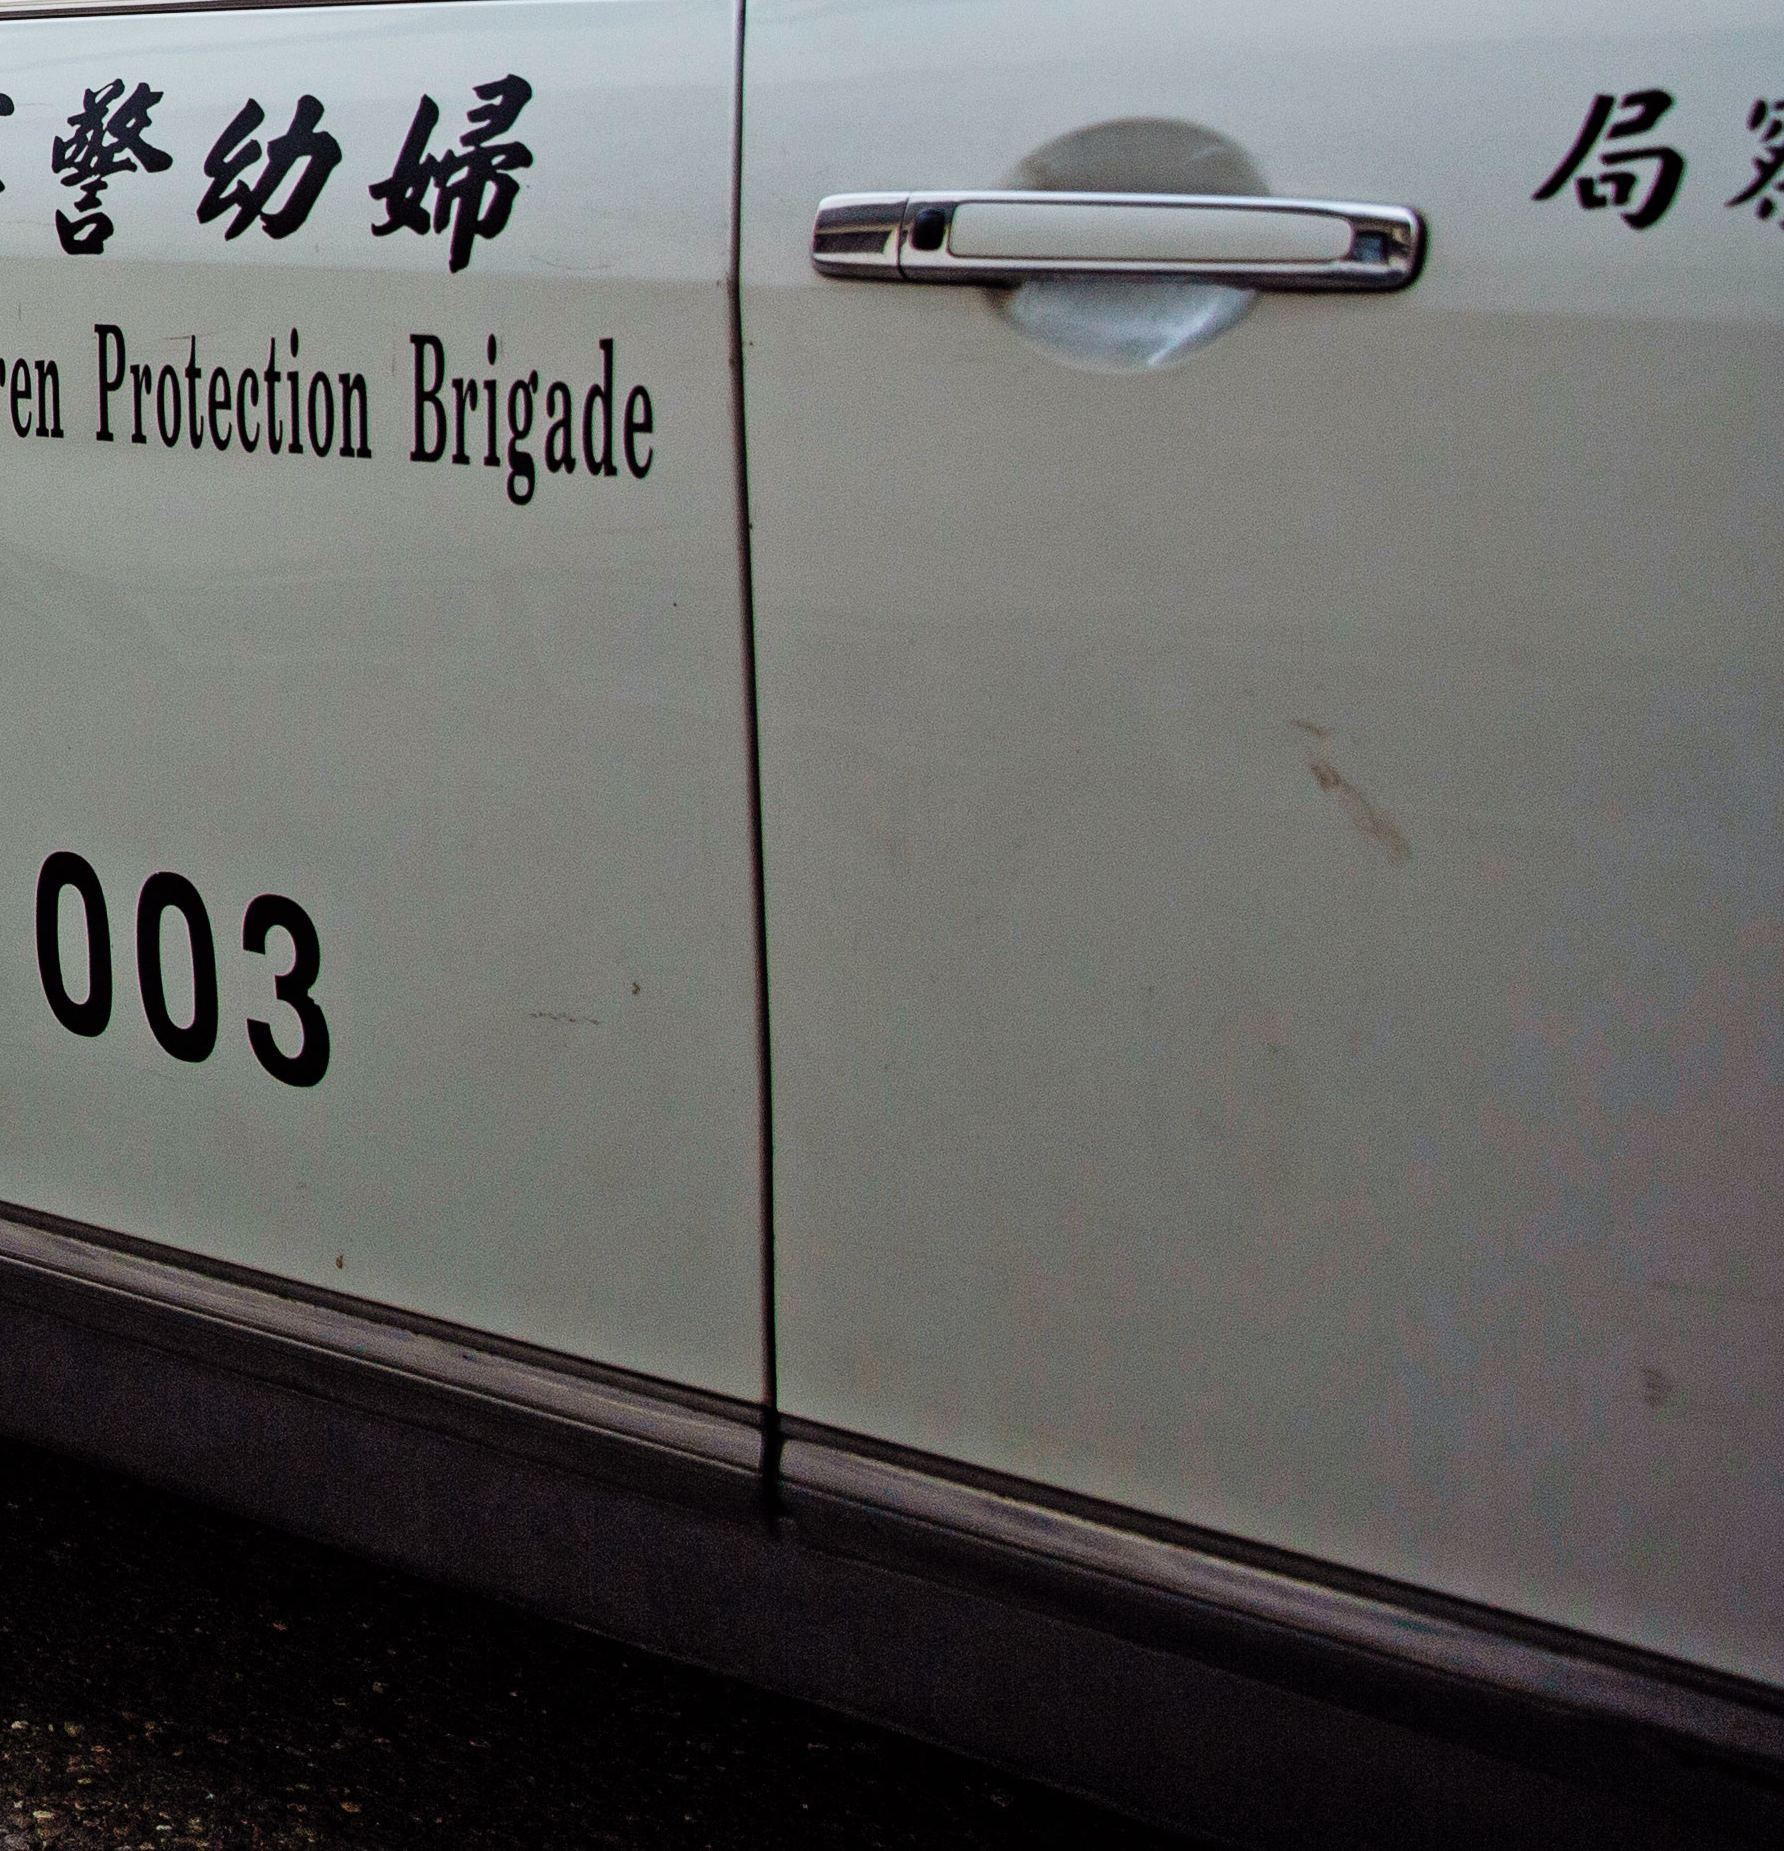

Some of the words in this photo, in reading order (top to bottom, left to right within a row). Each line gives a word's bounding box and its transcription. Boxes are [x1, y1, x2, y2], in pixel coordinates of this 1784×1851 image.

[94, 323, 373, 459] Protection
[409, 333, 654, 506] Brigade
[35, 850, 331, 1088] 003
